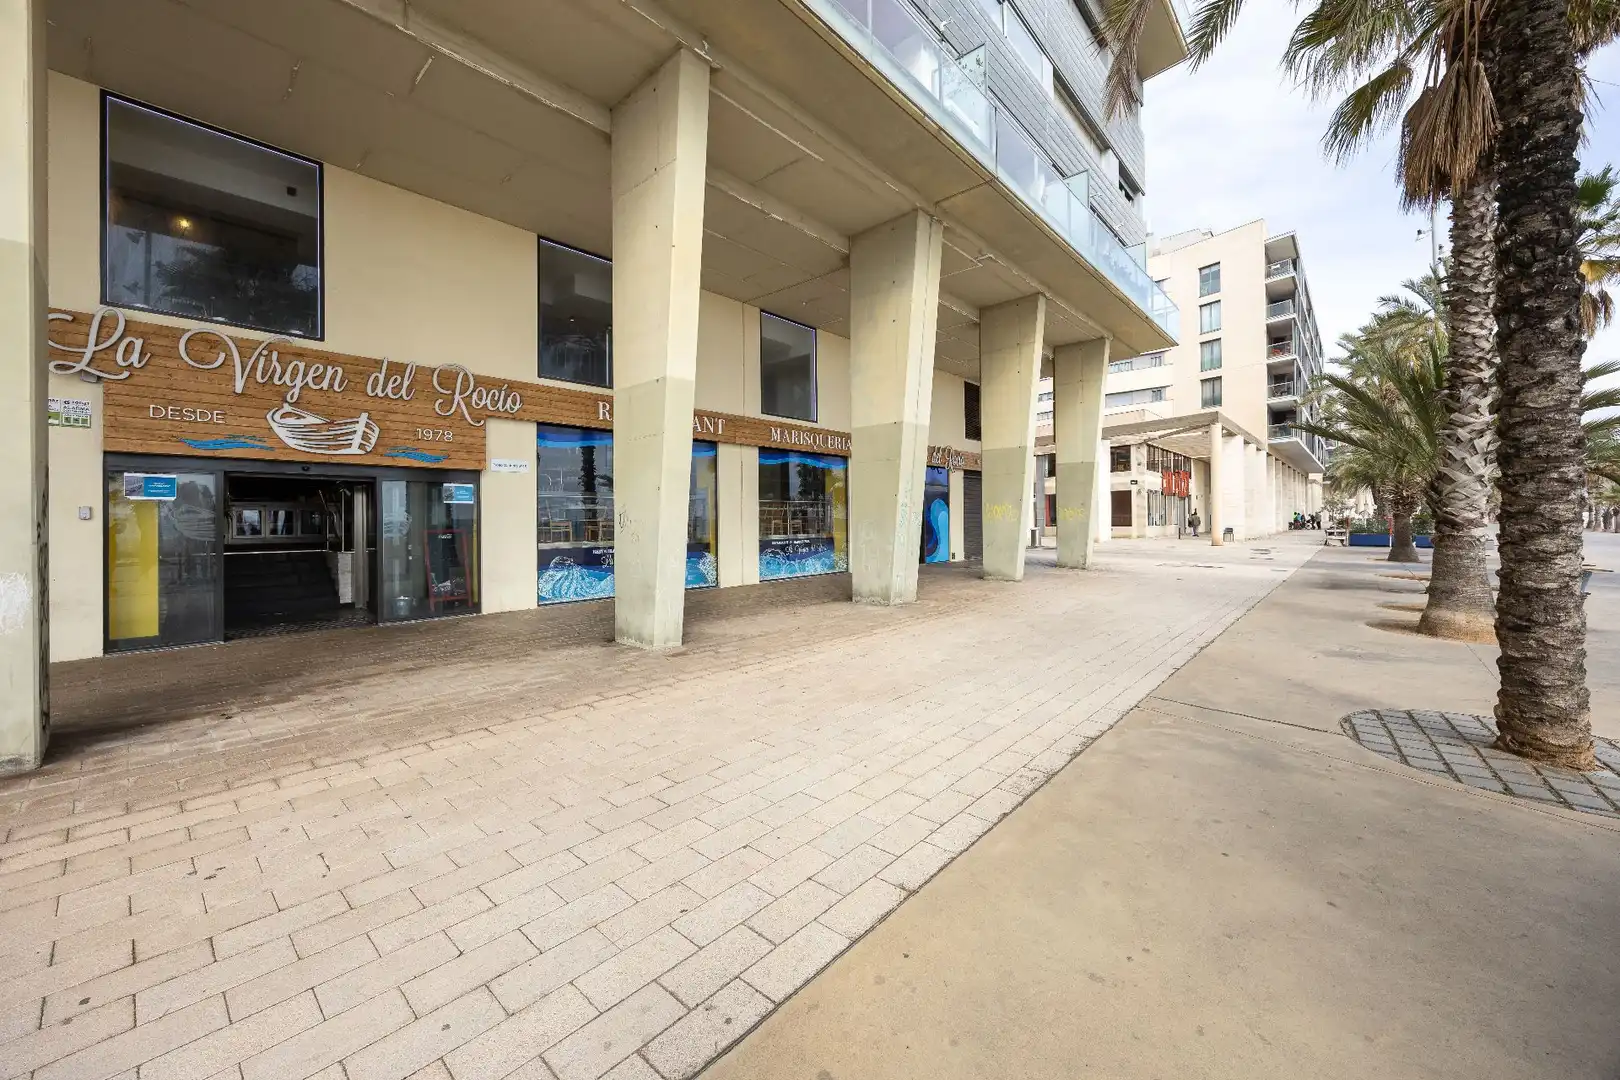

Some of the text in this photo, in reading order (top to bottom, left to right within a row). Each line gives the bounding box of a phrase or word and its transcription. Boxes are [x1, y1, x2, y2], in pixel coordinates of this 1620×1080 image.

[48, 306, 150, 380] La
[179, 328, 348, 403] Virgen
[366, 356, 416, 400] del
[432, 363, 523, 427] Rocío
[149, 404, 226, 424] DESDE
[415, 428, 453, 442] 1978
[770, 426, 853, 451] MARISQUERIA
